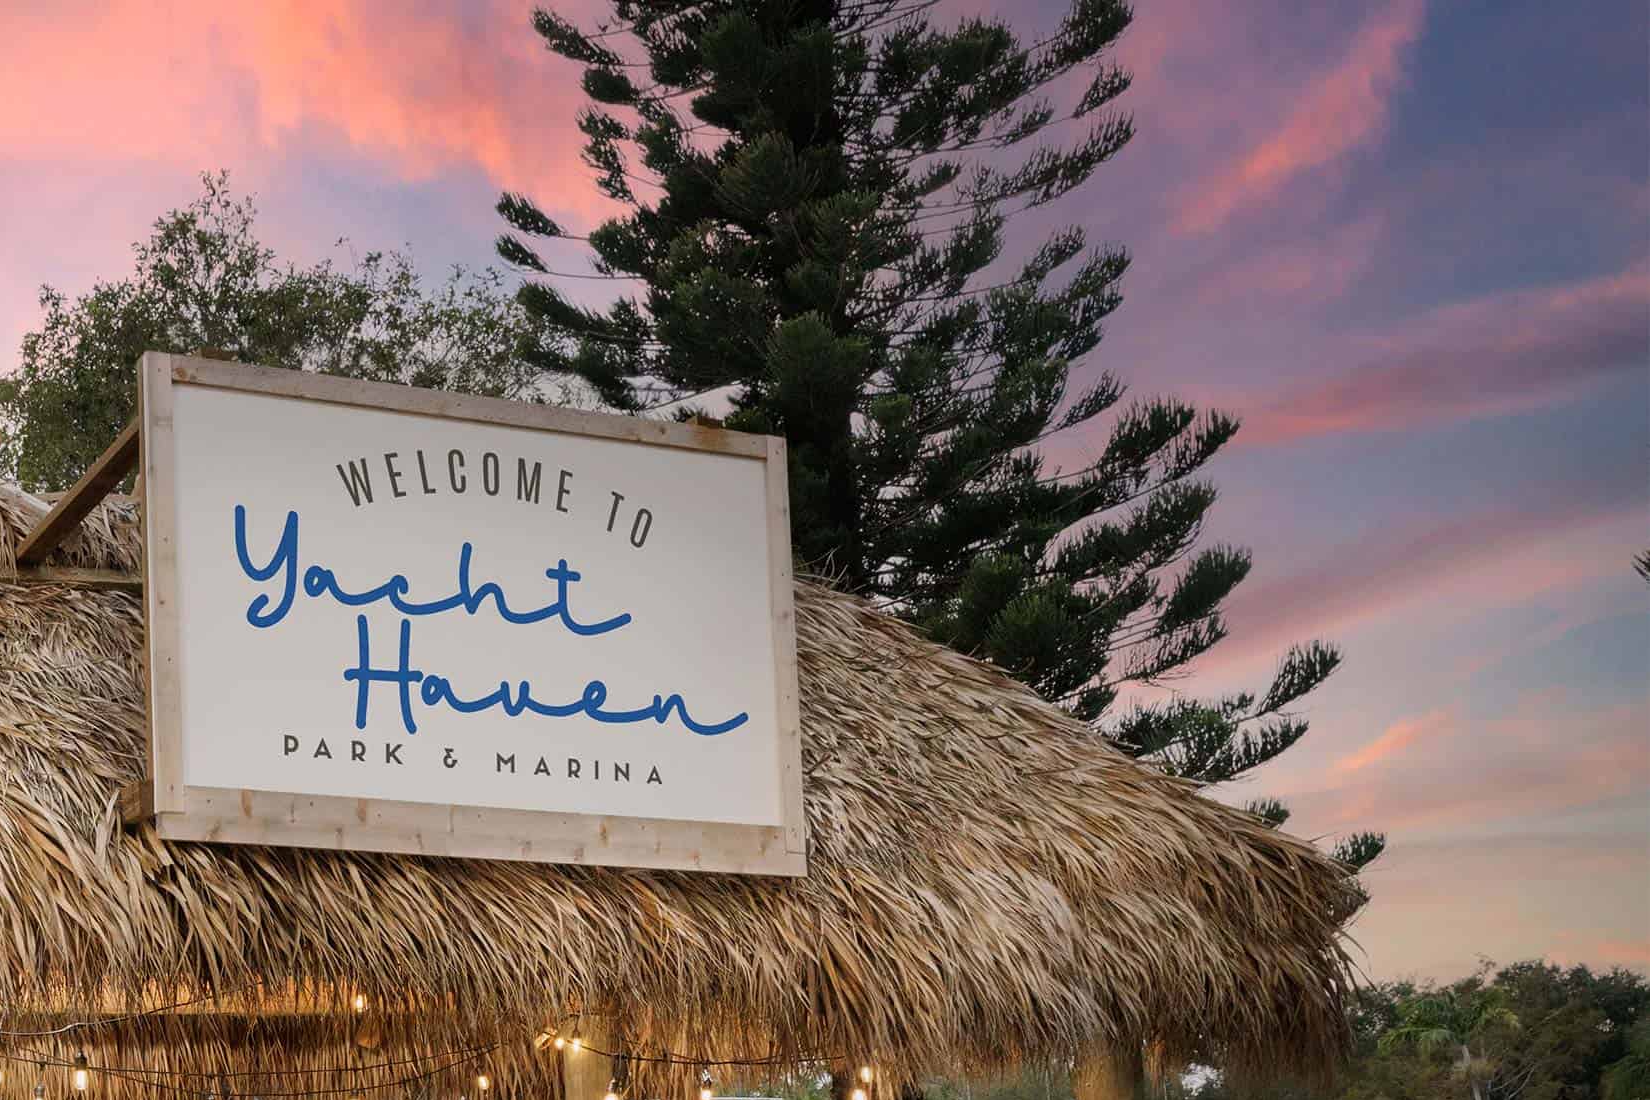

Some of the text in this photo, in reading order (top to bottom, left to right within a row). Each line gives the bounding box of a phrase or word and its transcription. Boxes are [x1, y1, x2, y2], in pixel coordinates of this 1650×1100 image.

[335, 448, 653, 549] WELCOME TO
[235, 504, 632, 636] Yacht
[344, 614, 749, 736] Haven
[284, 733, 663, 785] PARK & MARINA
